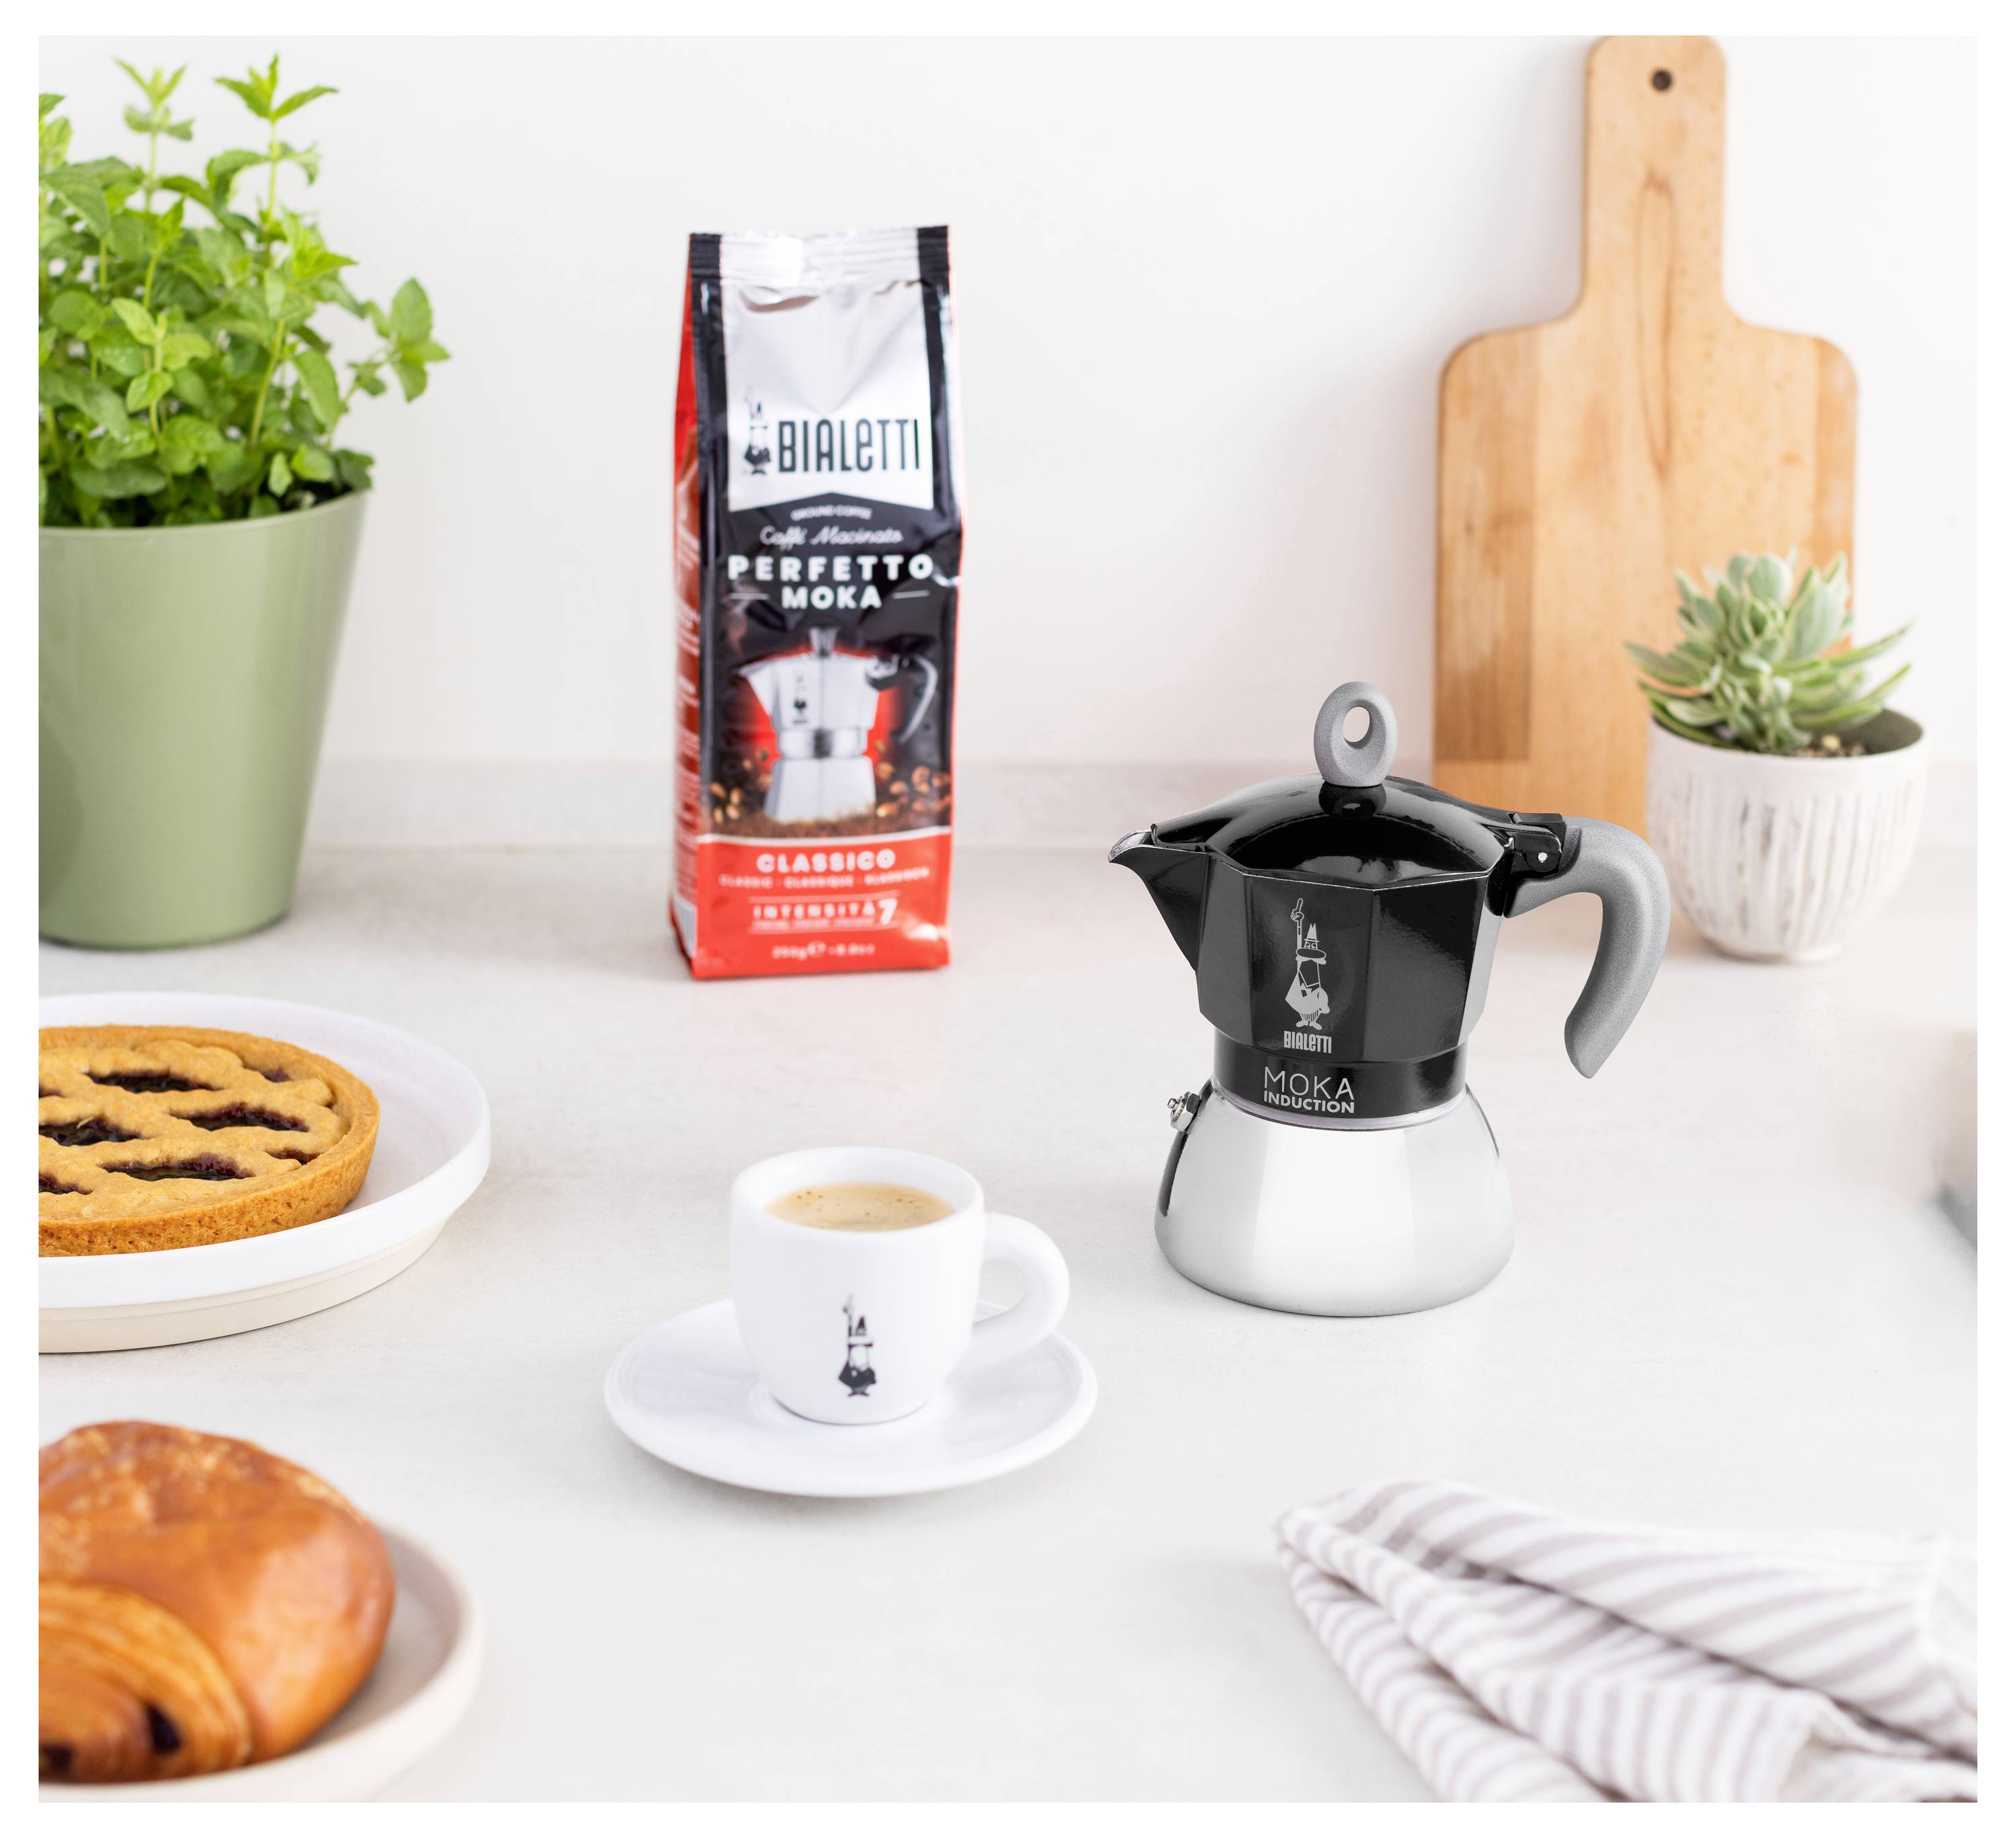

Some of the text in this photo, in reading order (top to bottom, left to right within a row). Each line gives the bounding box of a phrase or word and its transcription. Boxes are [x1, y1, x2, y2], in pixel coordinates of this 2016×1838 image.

[810, 526, 903, 545] Macinato
[728, 554, 933, 581] PERFETTO
[781, 586, 882, 609] MOKA
[756, 849, 896, 874] CLASSICO
[878, 898, 898, 925] 7
[1264, 1066, 1355, 1100] MOKA
[1263, 1090, 1355, 1114] INDUCTION
